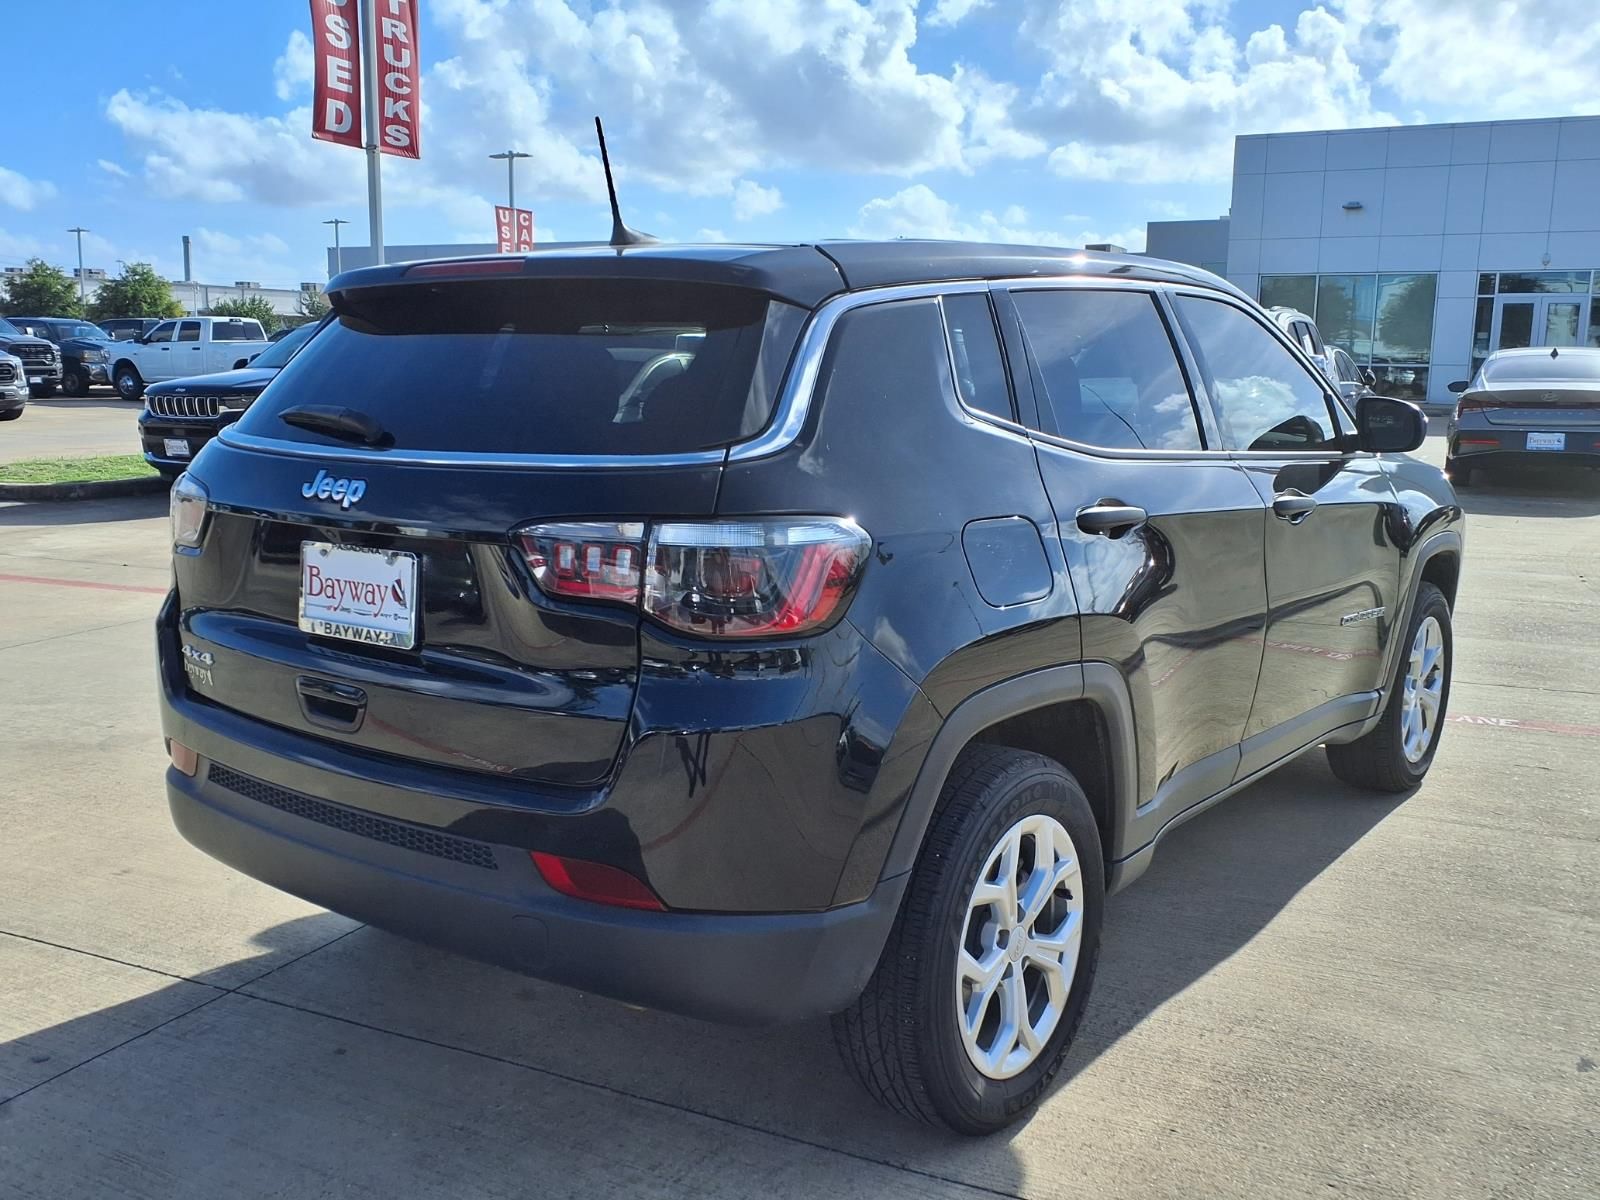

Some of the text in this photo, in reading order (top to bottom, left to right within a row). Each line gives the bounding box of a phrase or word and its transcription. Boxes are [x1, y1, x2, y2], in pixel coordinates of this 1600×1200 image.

[324, 0, 352, 133] SED
[302, 469, 366, 508] Jeep
[306, 565, 389, 618] Bayway
[1444, 715, 1519, 727] ANE
